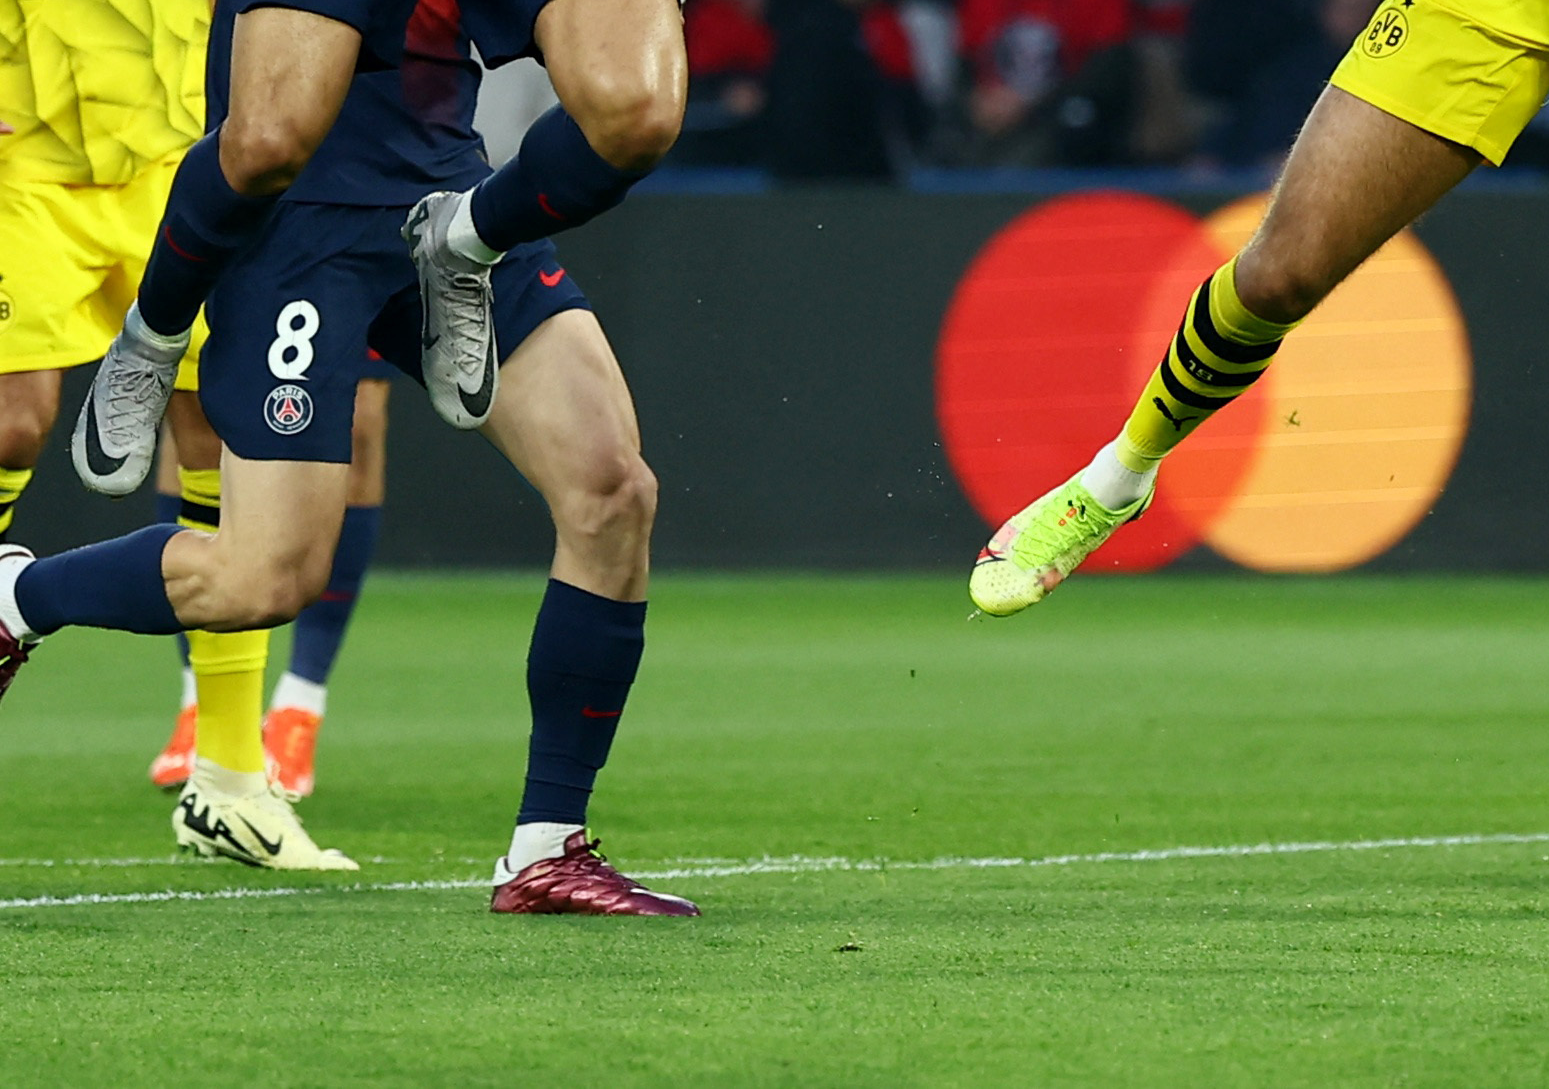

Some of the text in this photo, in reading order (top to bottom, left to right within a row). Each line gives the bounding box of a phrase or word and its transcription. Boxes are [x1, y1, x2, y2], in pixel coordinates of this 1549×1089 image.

[1368, 12, 1403, 47] BVB
[267, 300, 321, 380] 8
[272, 386, 304, 401] PARIS
